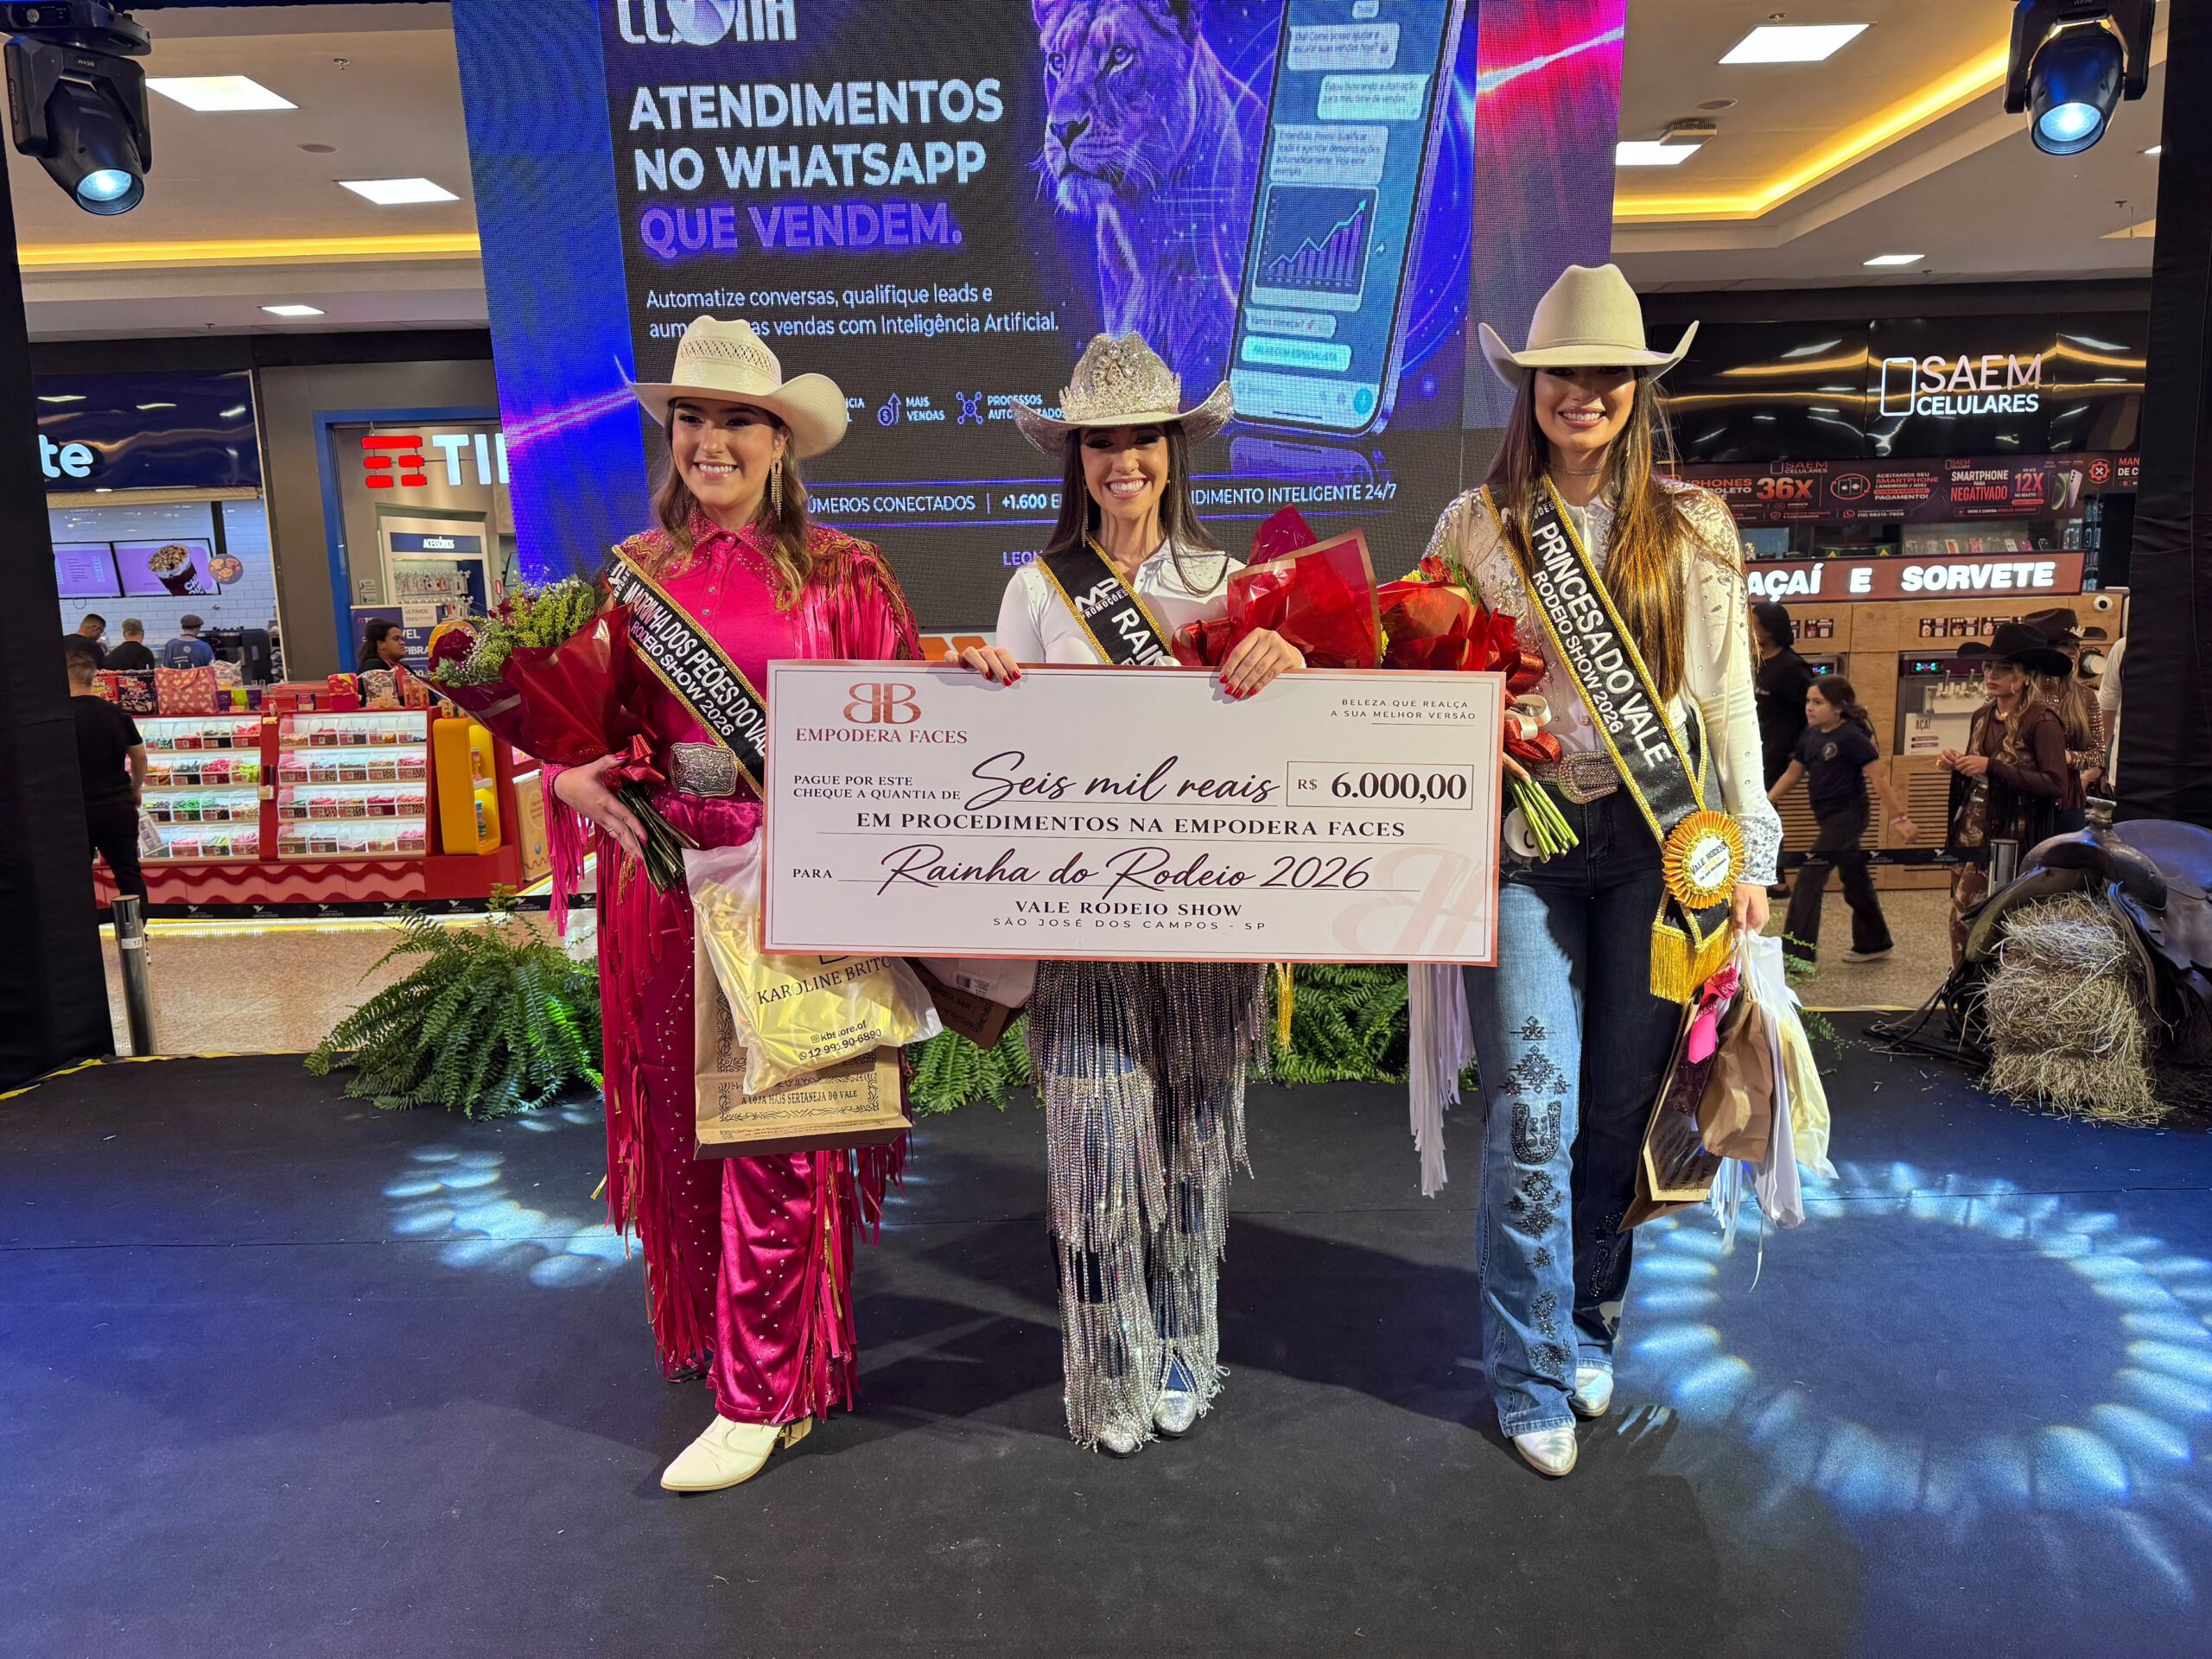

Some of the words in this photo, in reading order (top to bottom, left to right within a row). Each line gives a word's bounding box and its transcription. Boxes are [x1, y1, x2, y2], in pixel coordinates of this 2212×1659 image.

[628, 78, 1004, 130] ATENDIMENTOS
[635, 147, 704, 192] NO
[716, 141, 987, 188] WHATSAPP
[639, 207, 738, 256] QUE
[746, 203, 963, 249] VENDEM.
[646, 288, 746, 308] Automatize
[749, 289, 839, 308] conversas,
[842, 284, 930, 308] qualifique
[933, 283, 978, 303] leads
[982, 287, 993, 302] e
[649, 323, 689, 339] aum
[773, 317, 835, 337] vendas
[838, 319, 877, 335] com
[880, 313, 980, 338] Inteligência
[983, 314, 1060, 334] Artificial.
[1919, 353, 2044, 393] SAEM
[906, 396, 931, 409] MAIS
[1916, 393, 2040, 416] CELULARES
[906, 409, 946, 422] VENDAS
[38, 433, 94, 479] te
[1785, 461, 1828, 469] SAEM
[2118, 457, 2140, 466] MAN
[1875, 476, 1940, 485] SMARTPHONE
[1951, 469, 2009, 482] SMARTPHONE
[2117, 467, 2130, 476] DE
[2131, 467, 2139, 476] C
[1191, 488, 1265, 505] DIMENTO
[1268, 485, 1362, 503] INTELIGENTE
[1365, 480, 1397, 500] 24/7
[1688, 478, 1753, 488] PHONES
[806, 493, 871, 514] ÚMEROS
[873, 494, 976, 512] CONECTADOS
[1001, 493, 1046, 511] +1.600
[1950, 486, 2008, 502] NEGATIVADO
[1747, 563, 1825, 604] AÇAÍ
[1849, 568, 1873, 593] E
[1901, 561, 2057, 594] SORVETE
[1081, 589, 1129, 620] PROMOÇÕES
[1531, 521, 1613, 655] PRINCESA
[1594, 647, 1636, 695] DO
[1618, 691, 1674, 769] VALE
[1531, 569, 1574, 636] RODEIO
[1565, 635, 1603, 690] SHOW
[1592, 690, 1624, 734] 2026
[631, 620, 664, 658] RODEIO
[659, 653, 706, 702] SHOW
[699, 699, 734, 737] 2026
[659, 620, 698, 661] DOS
[683, 647, 740, 707] PEÕES
[726, 696, 753, 728] DO
[743, 717, 767, 759] VAL
[1330, 709, 1338, 718] A
[1428, 709, 1477, 720] VERSÃO
[1342, 698, 1387, 707] BELEZA
[1392, 700, 1417, 709] QUE
[1422, 701, 1469, 710] REALÇA
[1915, 717, 1931, 733] AÇAÍ
[795, 728, 902, 744] EMPODERA
[908, 729, 969, 744] FACES
[792, 787, 853, 800] CHEQUE
[856, 788, 867, 799] A
[870, 788, 937, 801] QUANTIA
[941, 790, 962, 801] DE
[963, 751, 1077, 811] Seis
[1084, 754, 1179, 803] mil
[1176, 773, 1281, 804] reais
[793, 774, 842, 787] PAGUE
[844, 775, 874, 786] POR
[878, 776, 913, 787] ESTE
[1297, 778, 1319, 791] R$
[1331, 771, 1468, 804] 6.000,00
[856, 811, 892, 829] EM
[900, 813, 1121, 832] PROCEDIMENTOS
[1129, 817, 1164, 834] NA
[1173, 817, 1319, 836] EMPODERA
[1327, 820, 1407, 837] FACES
[791, 867, 834, 880] PARA
[876, 843, 1040, 897] Rainha
[1048, 850, 1100, 886] do
[1102, 846, 1257, 900] Rodeio
[1258, 855, 1374, 890] 2026
[1691, 857, 1707, 875] VALE
[1014, 899, 1071, 915] VALE
[1079, 901, 1169, 917] RODEIO
[1177, 902, 1243, 917] SHOW
[992, 915, 1028, 928] SÃO
[1038, 916, 1084, 928] JOSÉ
[1094, 918, 1132, 930] DOS
[1141, 920, 1219, 931] CAMPOS
[1244, 921, 1267, 931] SP
[757, 970, 842, 1006] KAROLINE
[844, 956, 893, 982] BRITO
[809, 1046, 822, 1058] 12
[748, 1095, 766, 1105] LOJA
[768, 1094, 786, 1105] MAIS
[787, 1090, 827, 1104] SERTANEJA
[828, 1091, 837, 1101] DO
[840, 1089, 858, 1100] VALE
